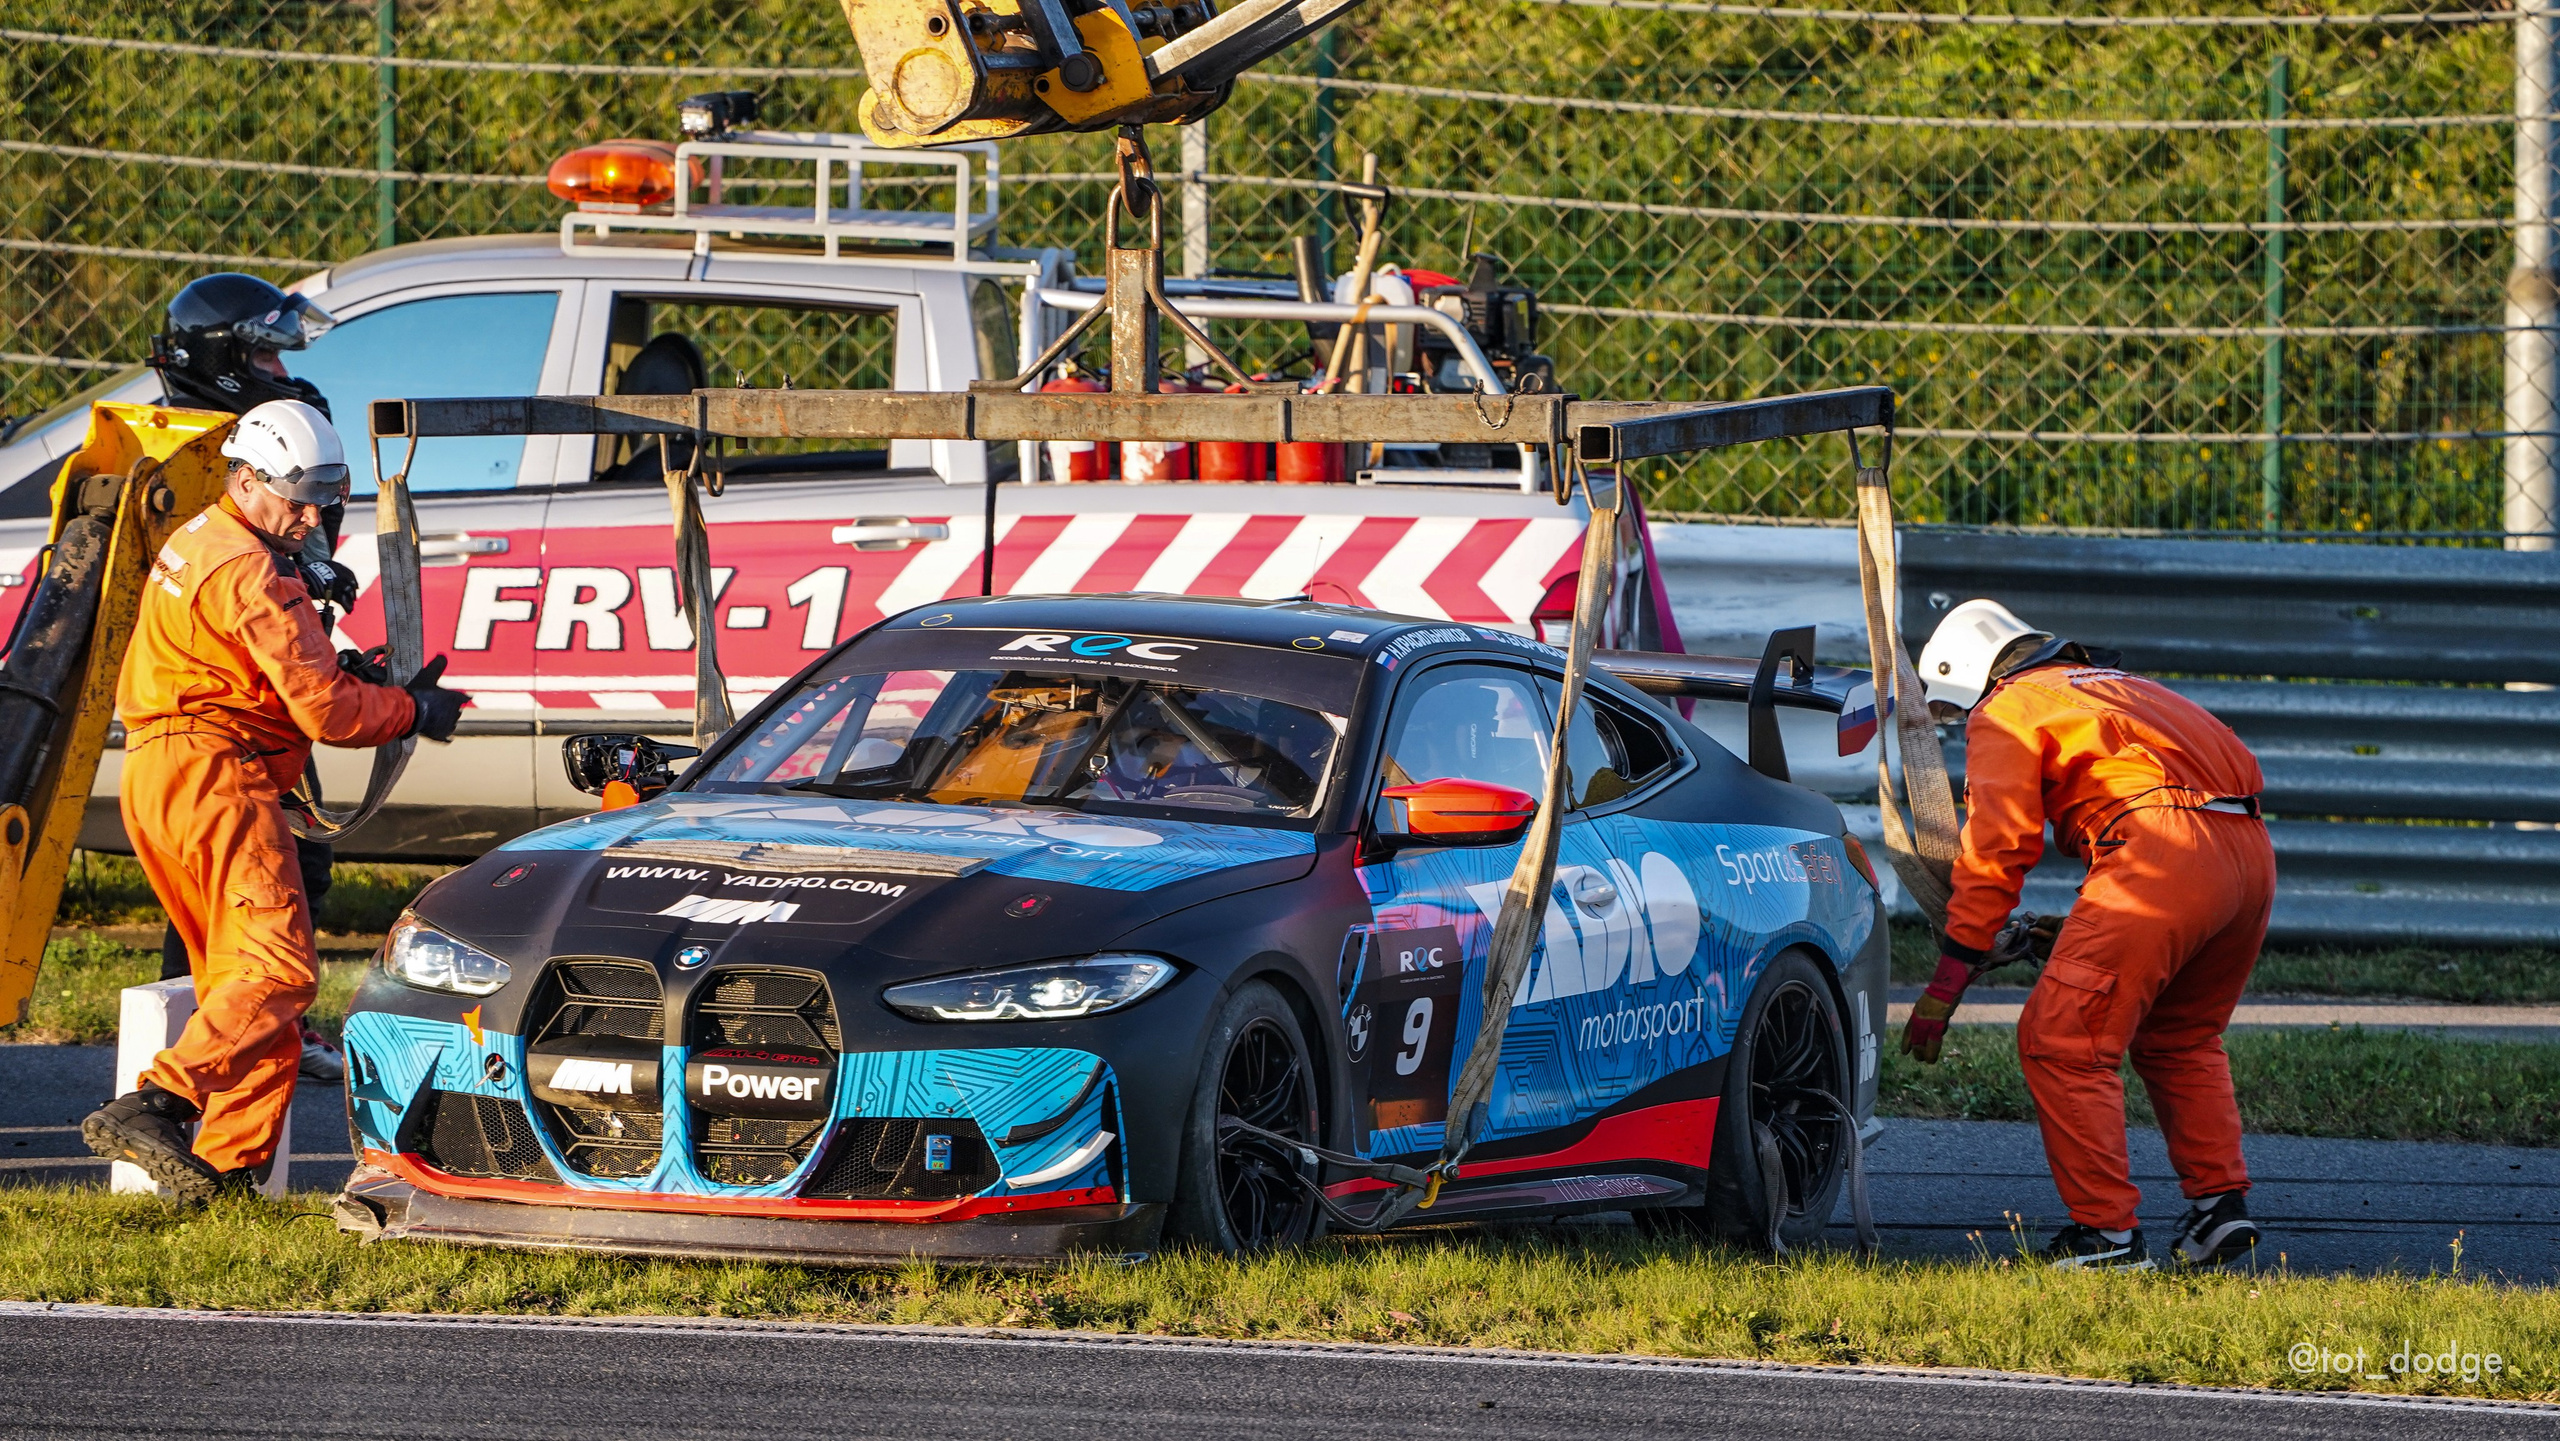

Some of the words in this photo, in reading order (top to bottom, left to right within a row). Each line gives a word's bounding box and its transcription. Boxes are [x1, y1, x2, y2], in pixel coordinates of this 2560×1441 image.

[453, 566, 850, 651] FRV-1
[1488, 630, 1568, 660] С.БОРИСО
[833, 824, 1124, 861] motorsport
[722, 872, 907, 898] YADRO.COM
[1395, 997, 1433, 1076] 9
[1579, 986, 1704, 1051] motorsport
[703, 1064, 820, 1101] Power
